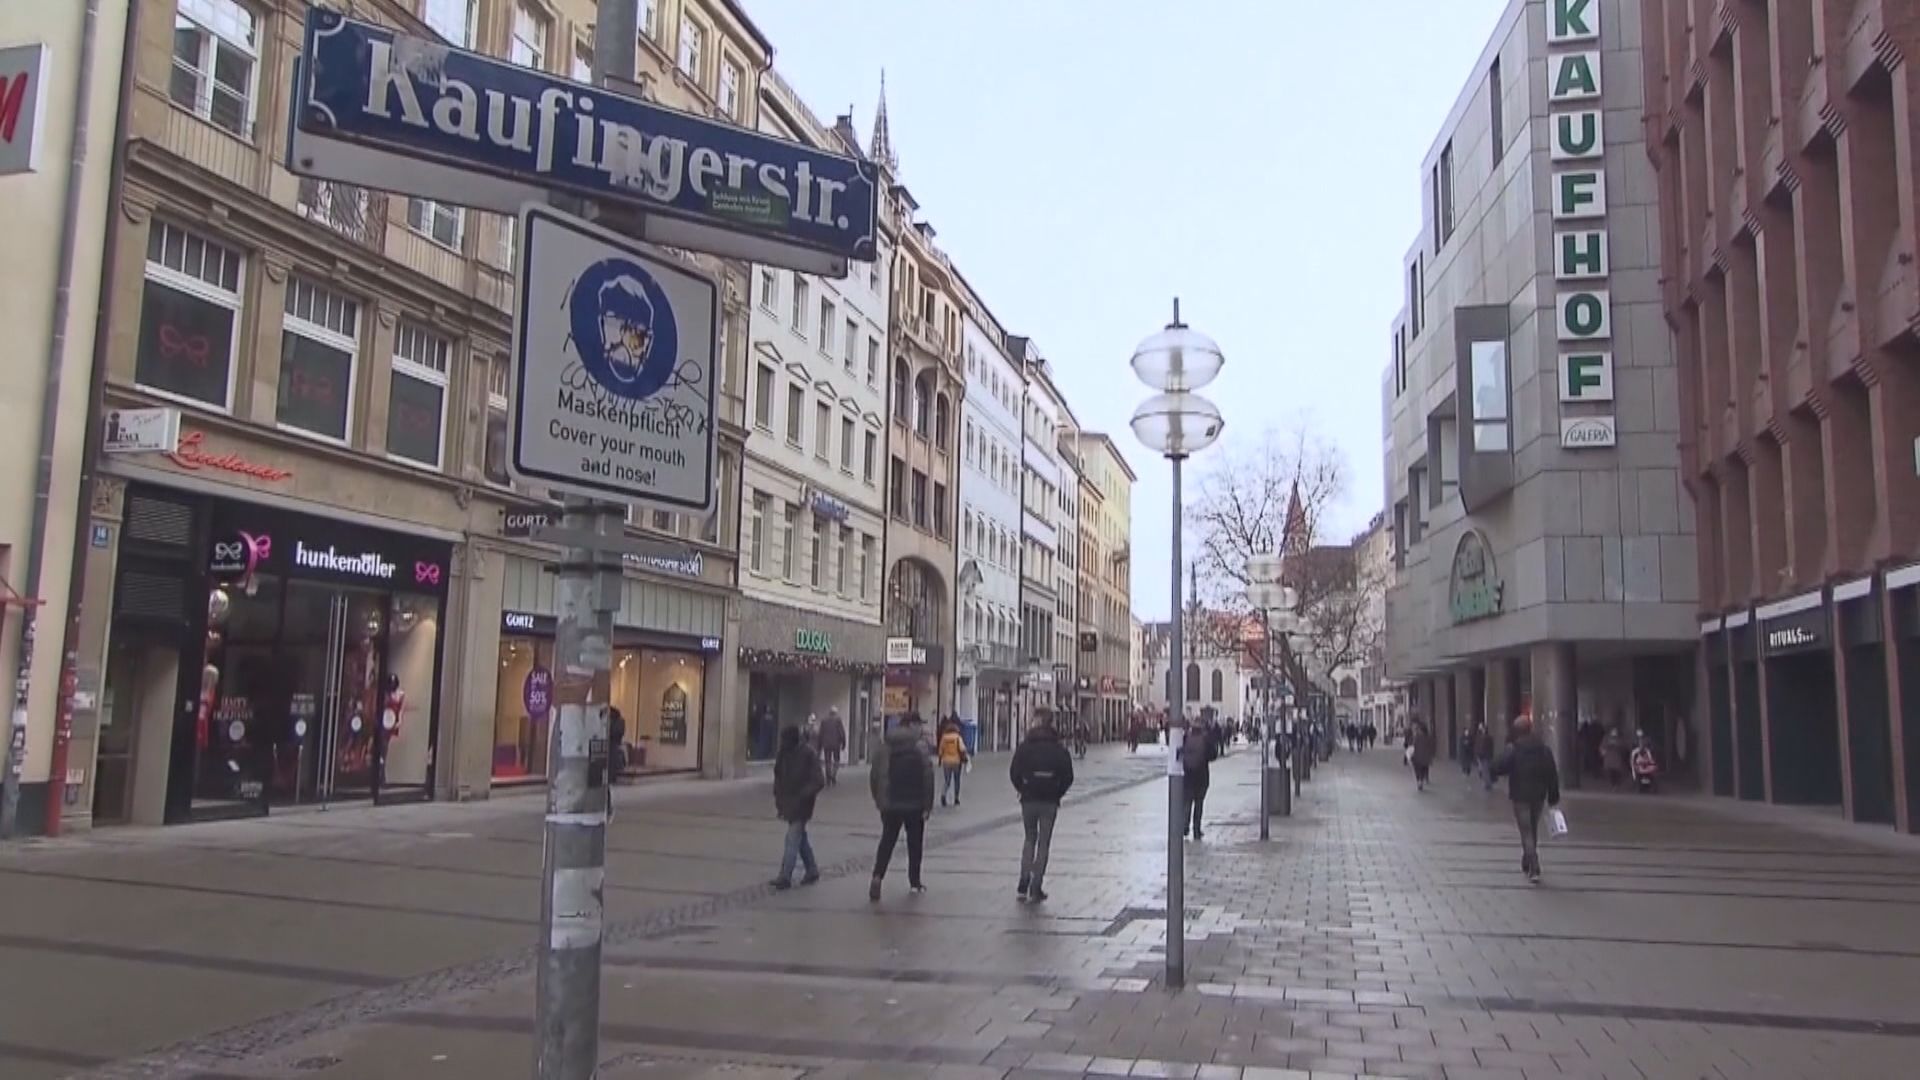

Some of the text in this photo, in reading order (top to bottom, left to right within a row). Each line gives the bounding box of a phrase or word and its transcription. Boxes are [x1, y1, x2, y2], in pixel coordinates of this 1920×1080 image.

[361, 38, 849, 231] Kaufingerstr.
[1554, 0, 1604, 397] KAUFHOF
[557, 388, 681, 440] Maskenpflicht
[1570, 427, 1609, 442] GALERIA
[549, 419, 686, 468] Cover your mouth
[581, 457, 657, 486] and nose!
[296, 541, 396, 578] hunkemöller
[796, 628, 832, 653] DOUGLAS
